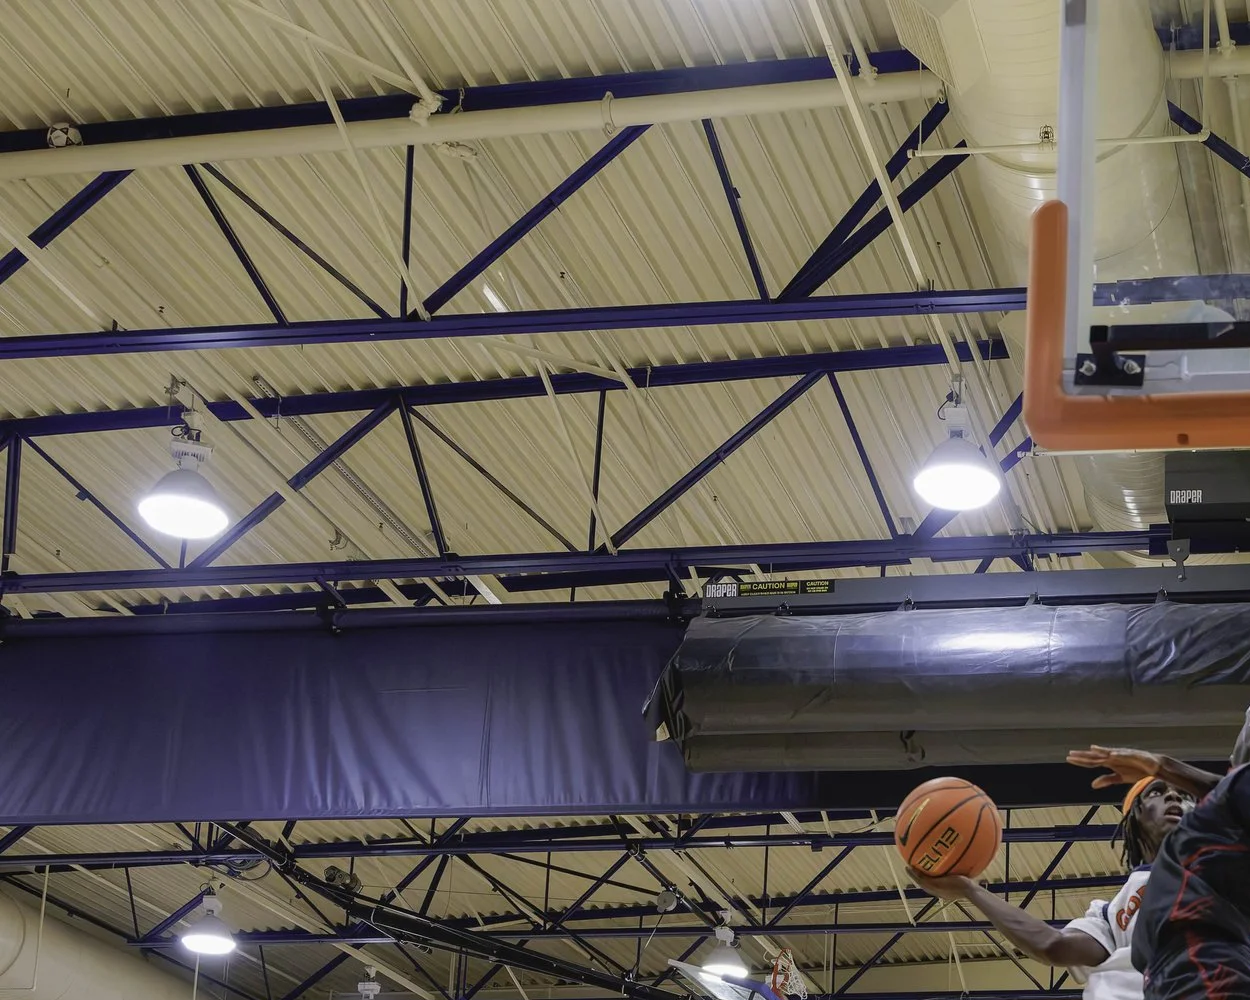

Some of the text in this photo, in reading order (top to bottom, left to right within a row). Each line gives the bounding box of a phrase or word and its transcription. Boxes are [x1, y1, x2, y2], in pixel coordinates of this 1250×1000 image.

[1170, 489, 1202, 504] DRAPER
[706, 583, 737, 598] DRAPER
[752, 582, 786, 590] CAUTION
[918, 826, 960, 871] ELITE
